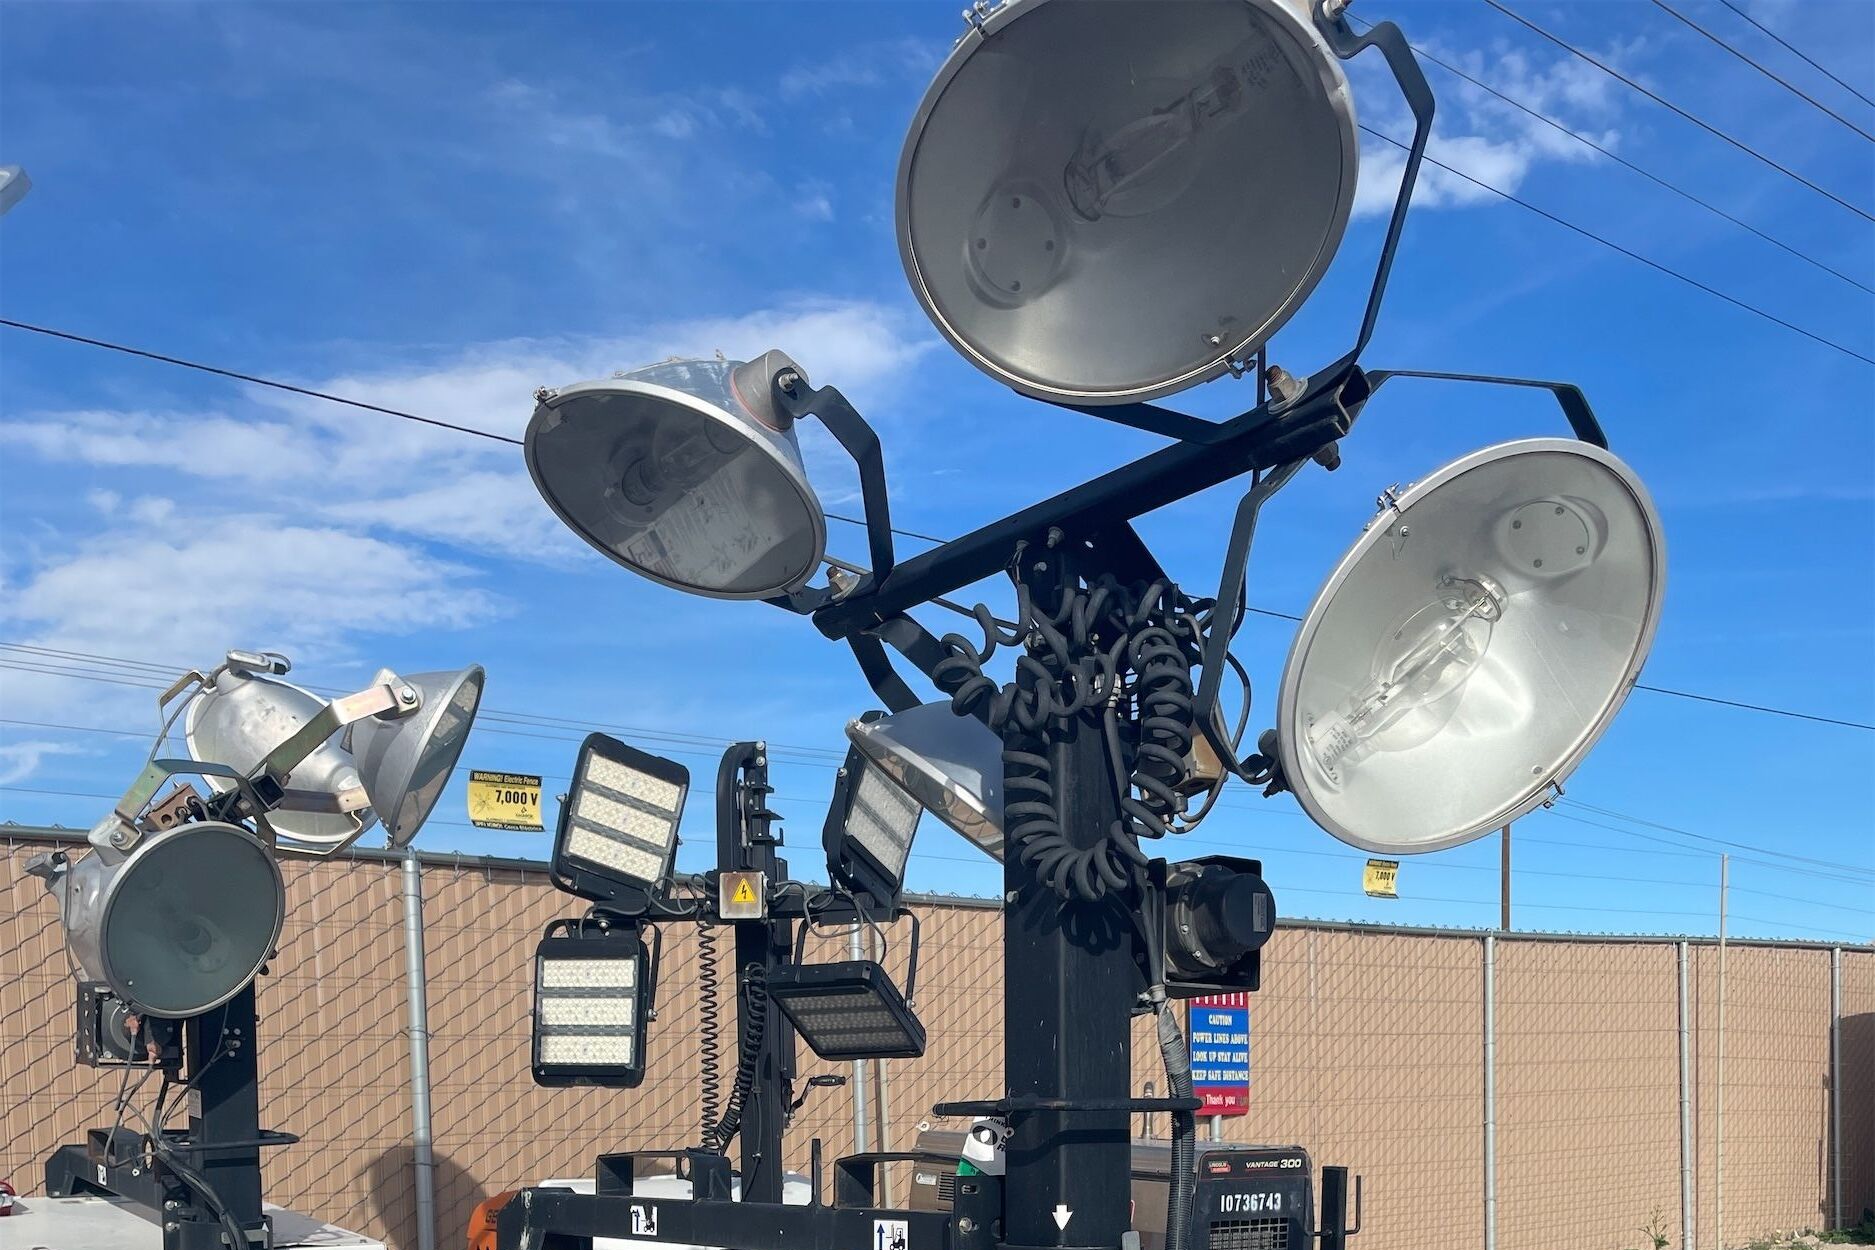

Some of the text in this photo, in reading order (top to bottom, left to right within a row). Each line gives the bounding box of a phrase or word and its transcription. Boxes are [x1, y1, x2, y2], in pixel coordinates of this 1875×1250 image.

[504, 775, 523, 784] Electric
[496, 790, 538, 806] 7,000 V
[1208, 1014, 1233, 1026] CAUTION
[1192, 1032, 1248, 1045] POWER LINES ABOVE
[1192, 1051, 1248, 1063] LOOK UP STAY ALIVE
[1191, 1069, 1249, 1081] KEEP SAFE DISTANCE
[1206, 1093, 1236, 1107] Thank you
[1245, 1158, 1302, 1169] VANTAGE 300
[1220, 1192, 1282, 1213] 10736743
